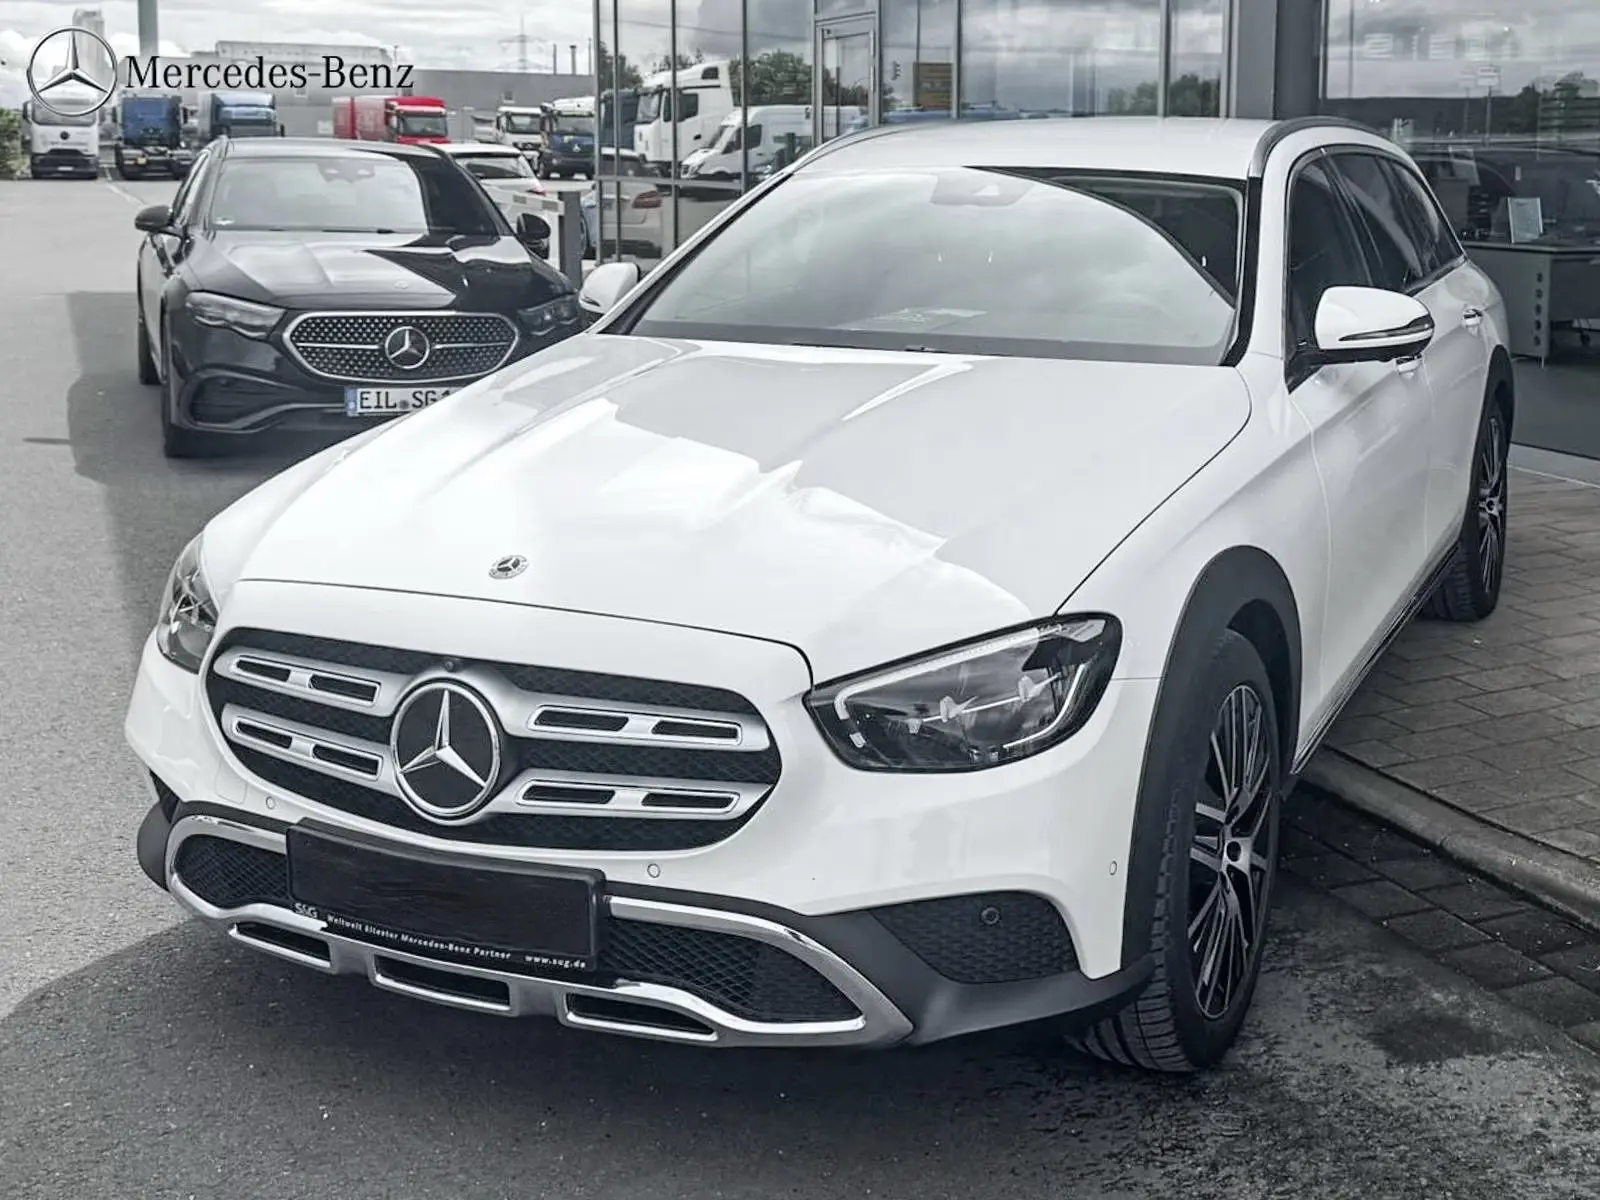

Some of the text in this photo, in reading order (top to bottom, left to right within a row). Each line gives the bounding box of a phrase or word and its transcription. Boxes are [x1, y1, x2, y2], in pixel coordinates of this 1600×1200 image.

[360, 391, 397, 409] EIL
[327, 914, 362, 931] Weltweit
[401, 933, 471, 955] Mercedes-Benz
[473, 946, 511, 960] Partner
